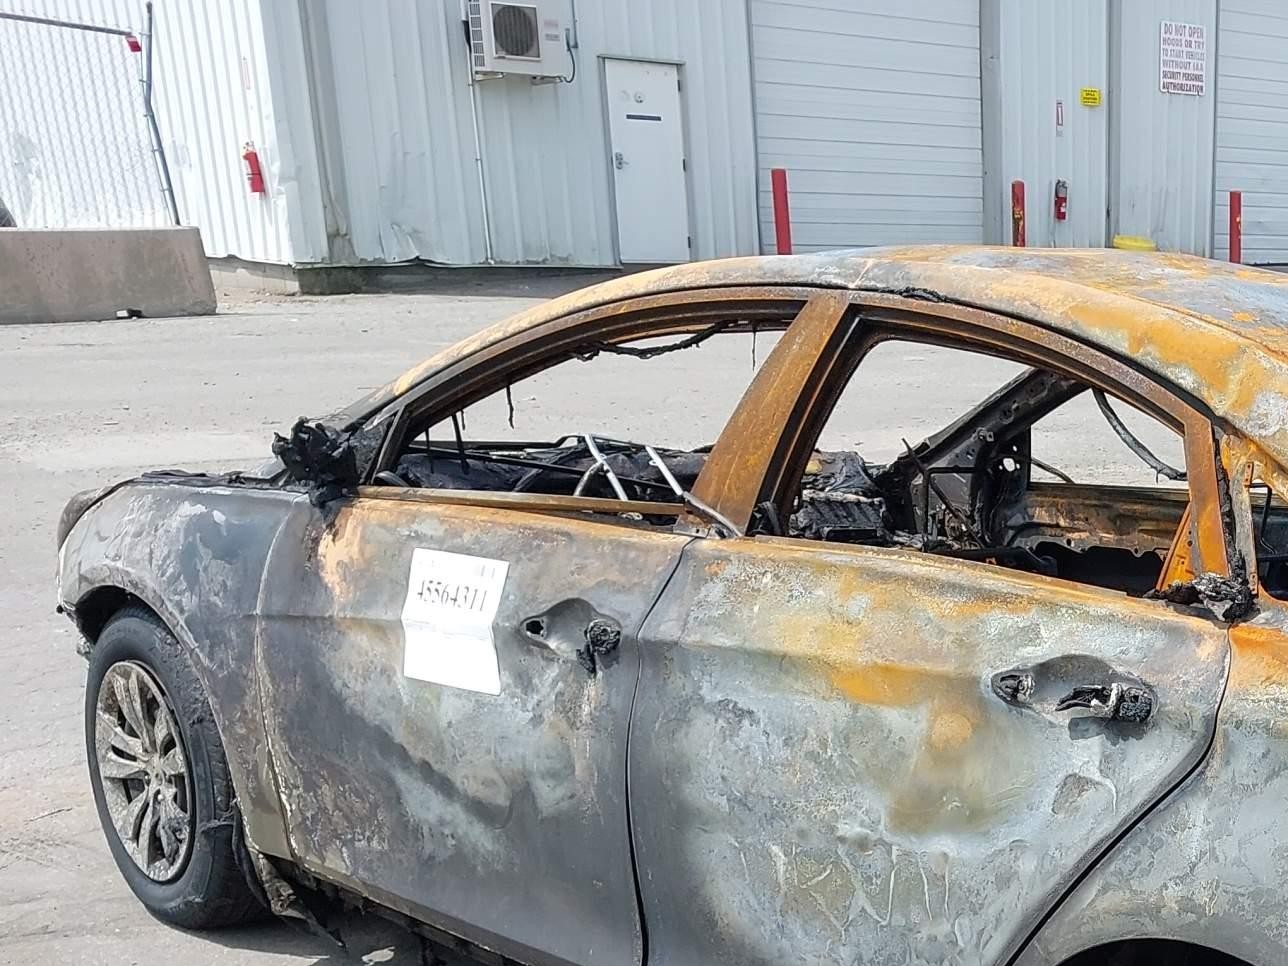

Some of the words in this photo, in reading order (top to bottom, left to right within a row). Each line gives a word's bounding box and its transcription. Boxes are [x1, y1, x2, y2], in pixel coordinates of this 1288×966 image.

[1164, 23, 1173, 35] DO
[1174, 23, 1186, 37] NOT
[1188, 26, 1204, 39] OPEN
[1162, 37, 1183, 48] HOODS
[1184, 39, 1193, 49] OR
[1194, 40, 1204, 50] TRY
[1162, 48, 1168, 57] TO
[1162, 59, 1191, 70] WITHOUT
[1162, 70, 1181, 80] SECURITY
[1182, 72, 1204, 82] PERSONNEL
[1162, 81, 1204, 93] AUTHORIZATION
[416, 580, 488, 611] 45564311
